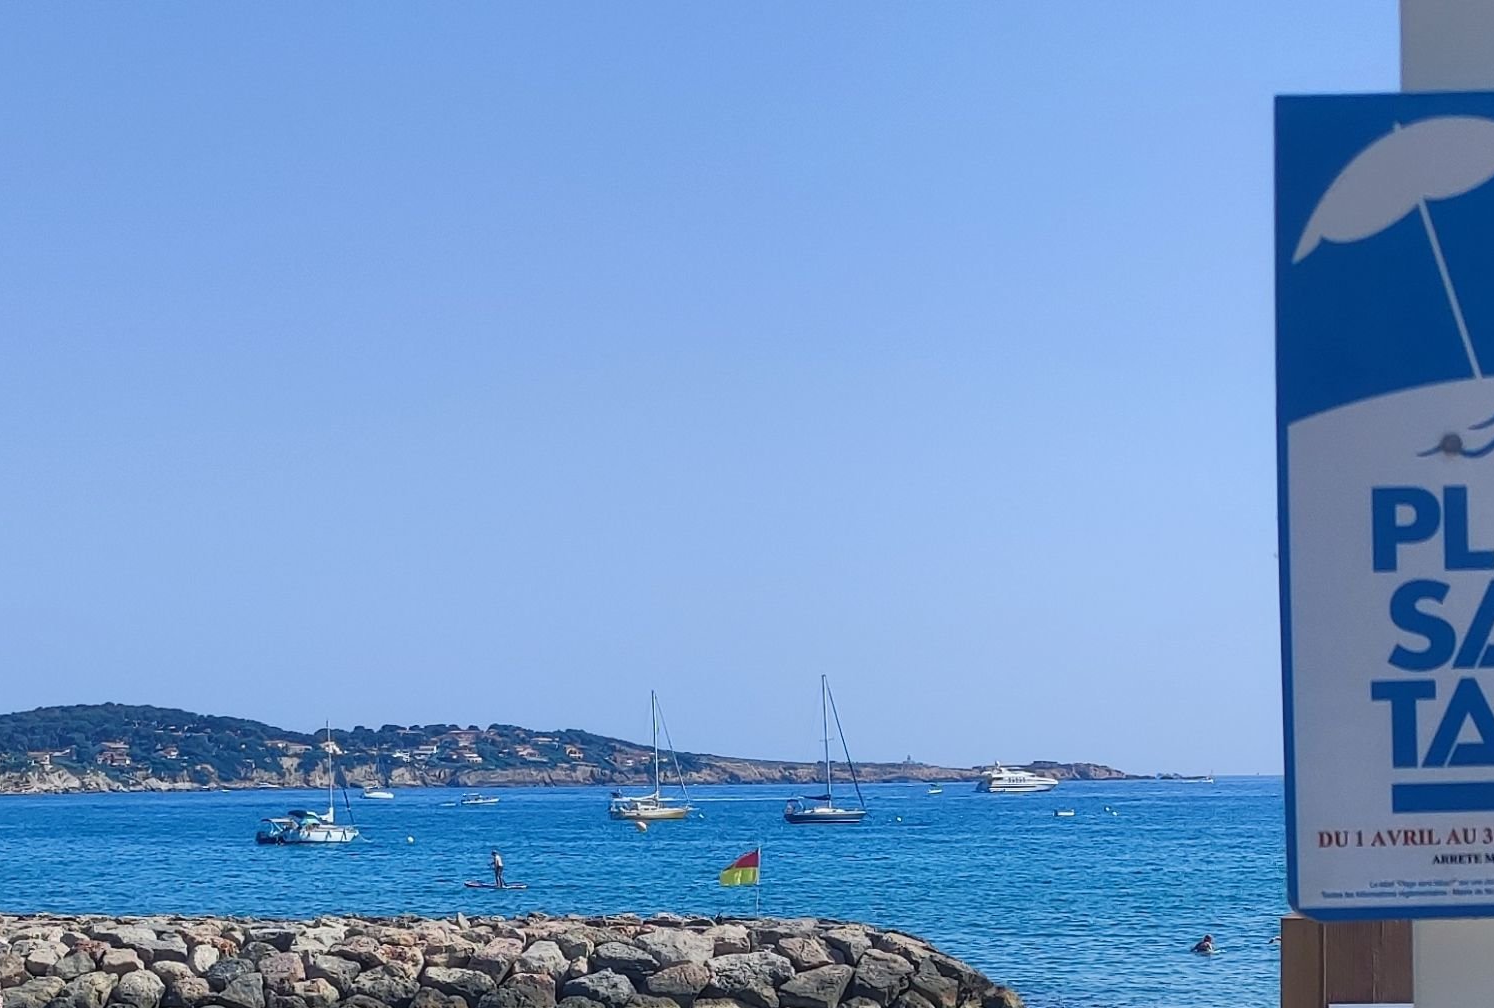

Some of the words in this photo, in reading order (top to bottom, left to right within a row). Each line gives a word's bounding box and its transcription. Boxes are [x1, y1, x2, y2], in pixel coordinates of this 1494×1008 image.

[1318, 831, 1349, 848] DU
[1356, 831, 1364, 847] 1
[1371, 828, 1441, 848] AVRIL
[1446, 828, 1477, 845] AU
